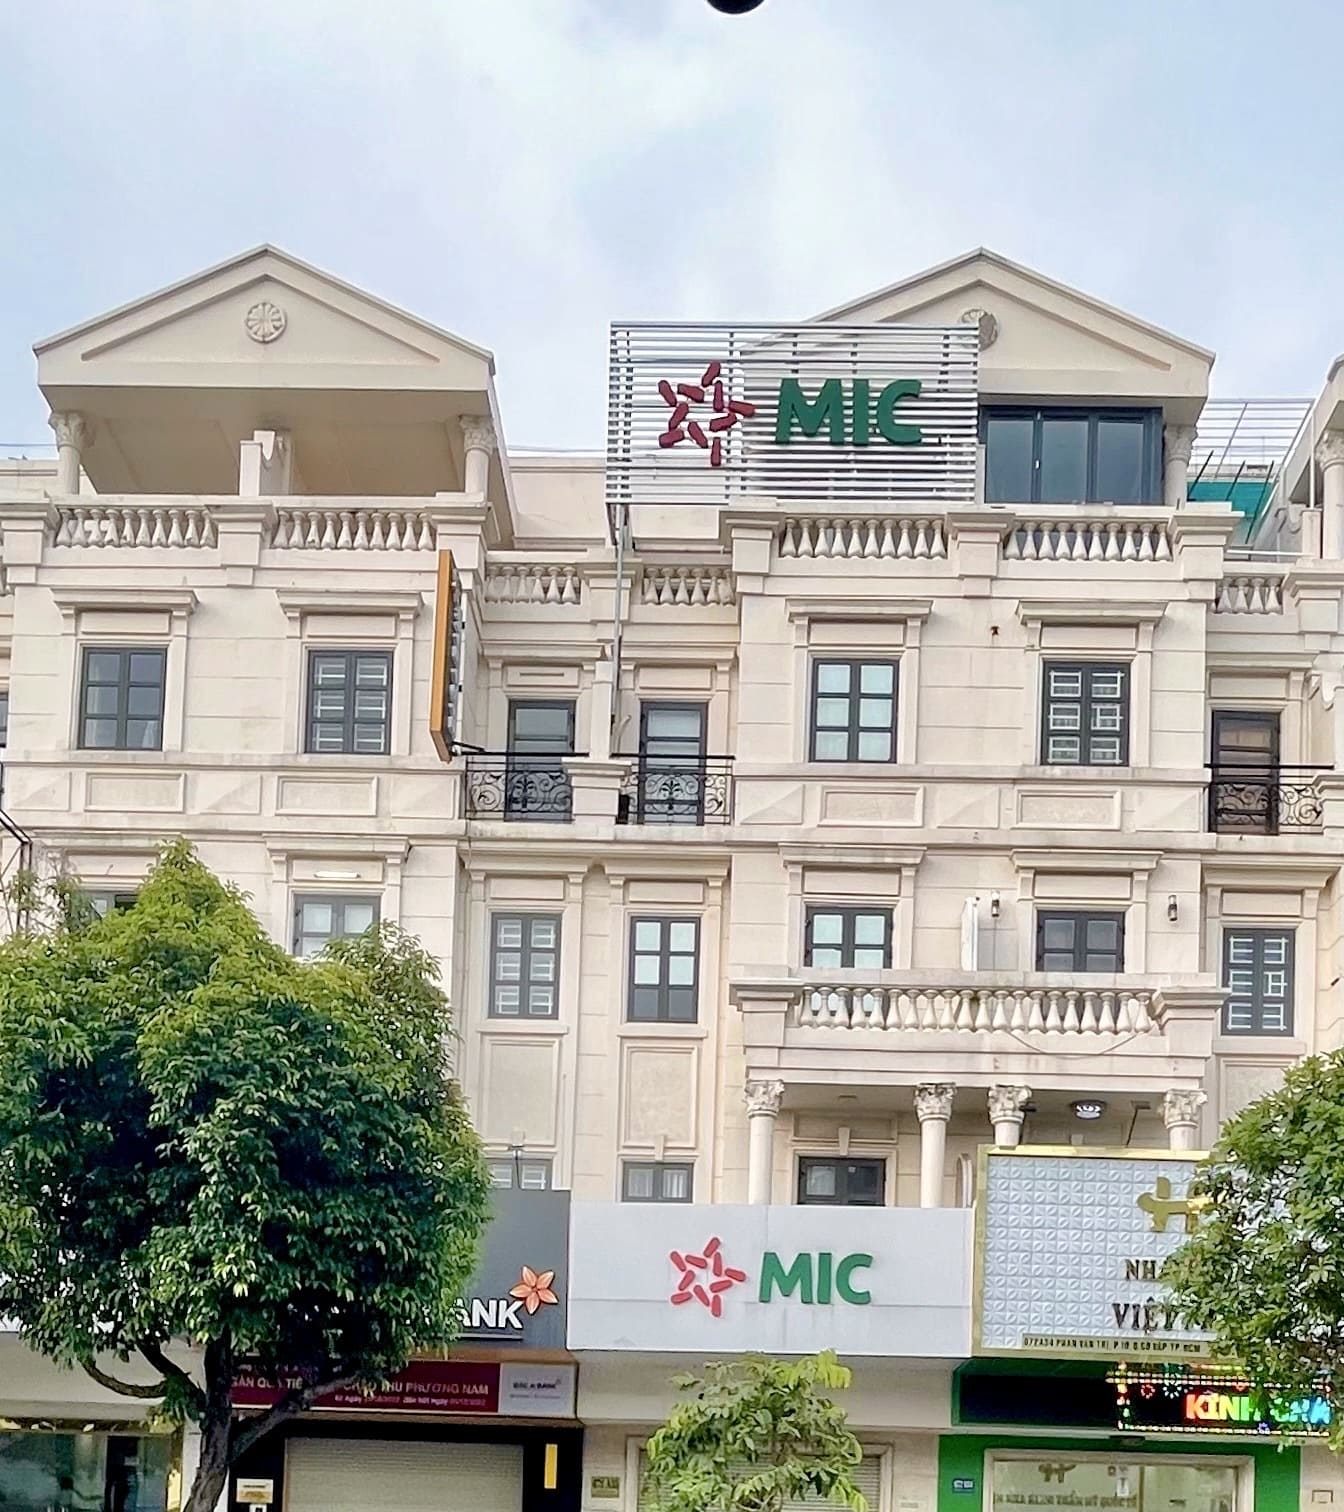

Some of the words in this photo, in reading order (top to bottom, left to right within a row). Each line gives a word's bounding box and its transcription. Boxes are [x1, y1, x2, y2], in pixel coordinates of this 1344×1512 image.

[775, 378, 923, 446] MIC
[758, 1251, 875, 1306] MIC
[462, 1383, 489, 1395] NAM
